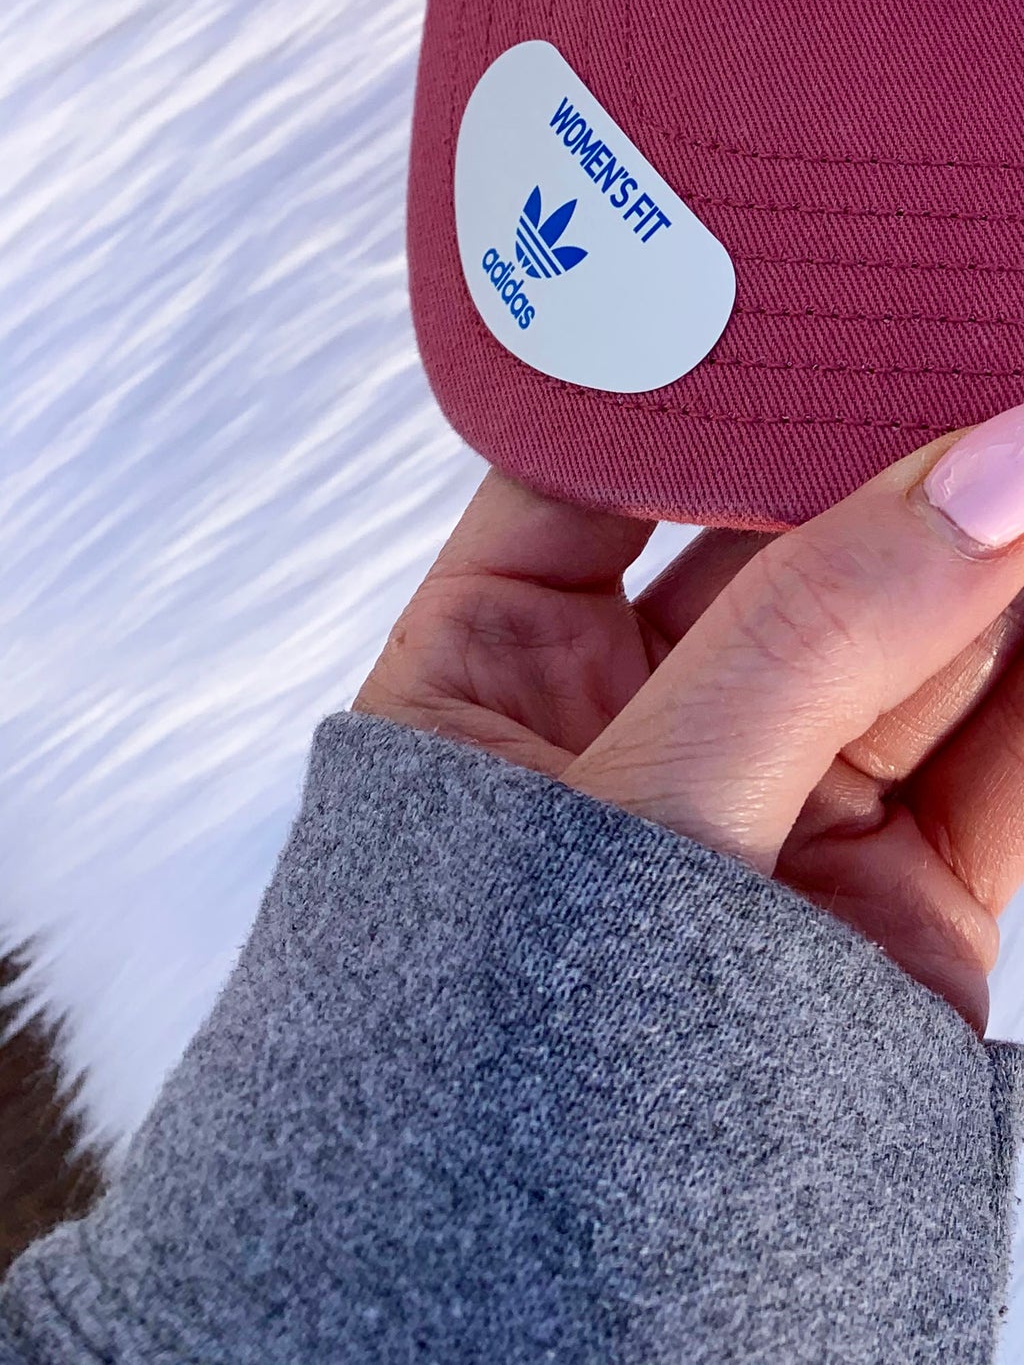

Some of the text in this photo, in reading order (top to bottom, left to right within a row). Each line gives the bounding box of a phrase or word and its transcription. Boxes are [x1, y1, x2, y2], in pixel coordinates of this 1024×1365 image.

[550, 97, 672, 243] WOMEN'S FIT
[482, 248, 535, 329] adidas
